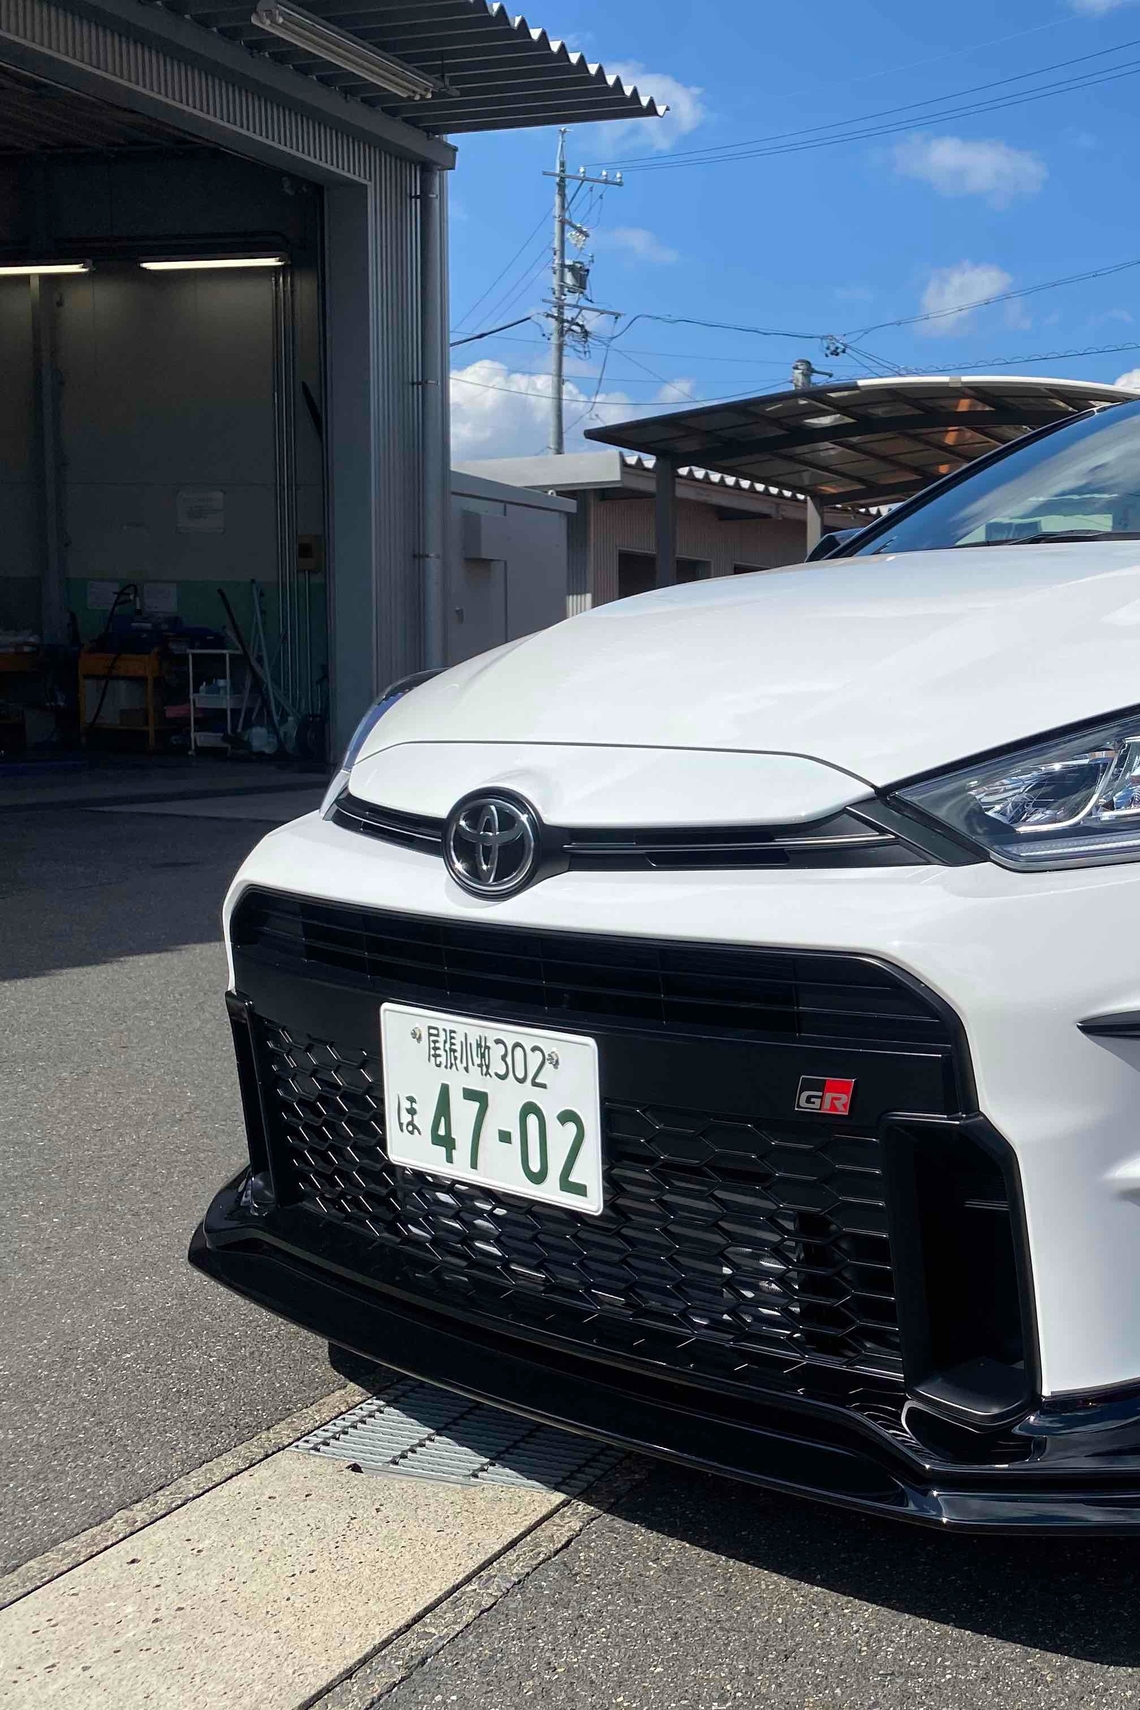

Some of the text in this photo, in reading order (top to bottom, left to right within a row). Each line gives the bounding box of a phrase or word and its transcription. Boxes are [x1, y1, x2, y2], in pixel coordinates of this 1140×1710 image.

[800, 1091, 848, 1112] GR
[397, 1083, 588, 1198] ほ 47-02
